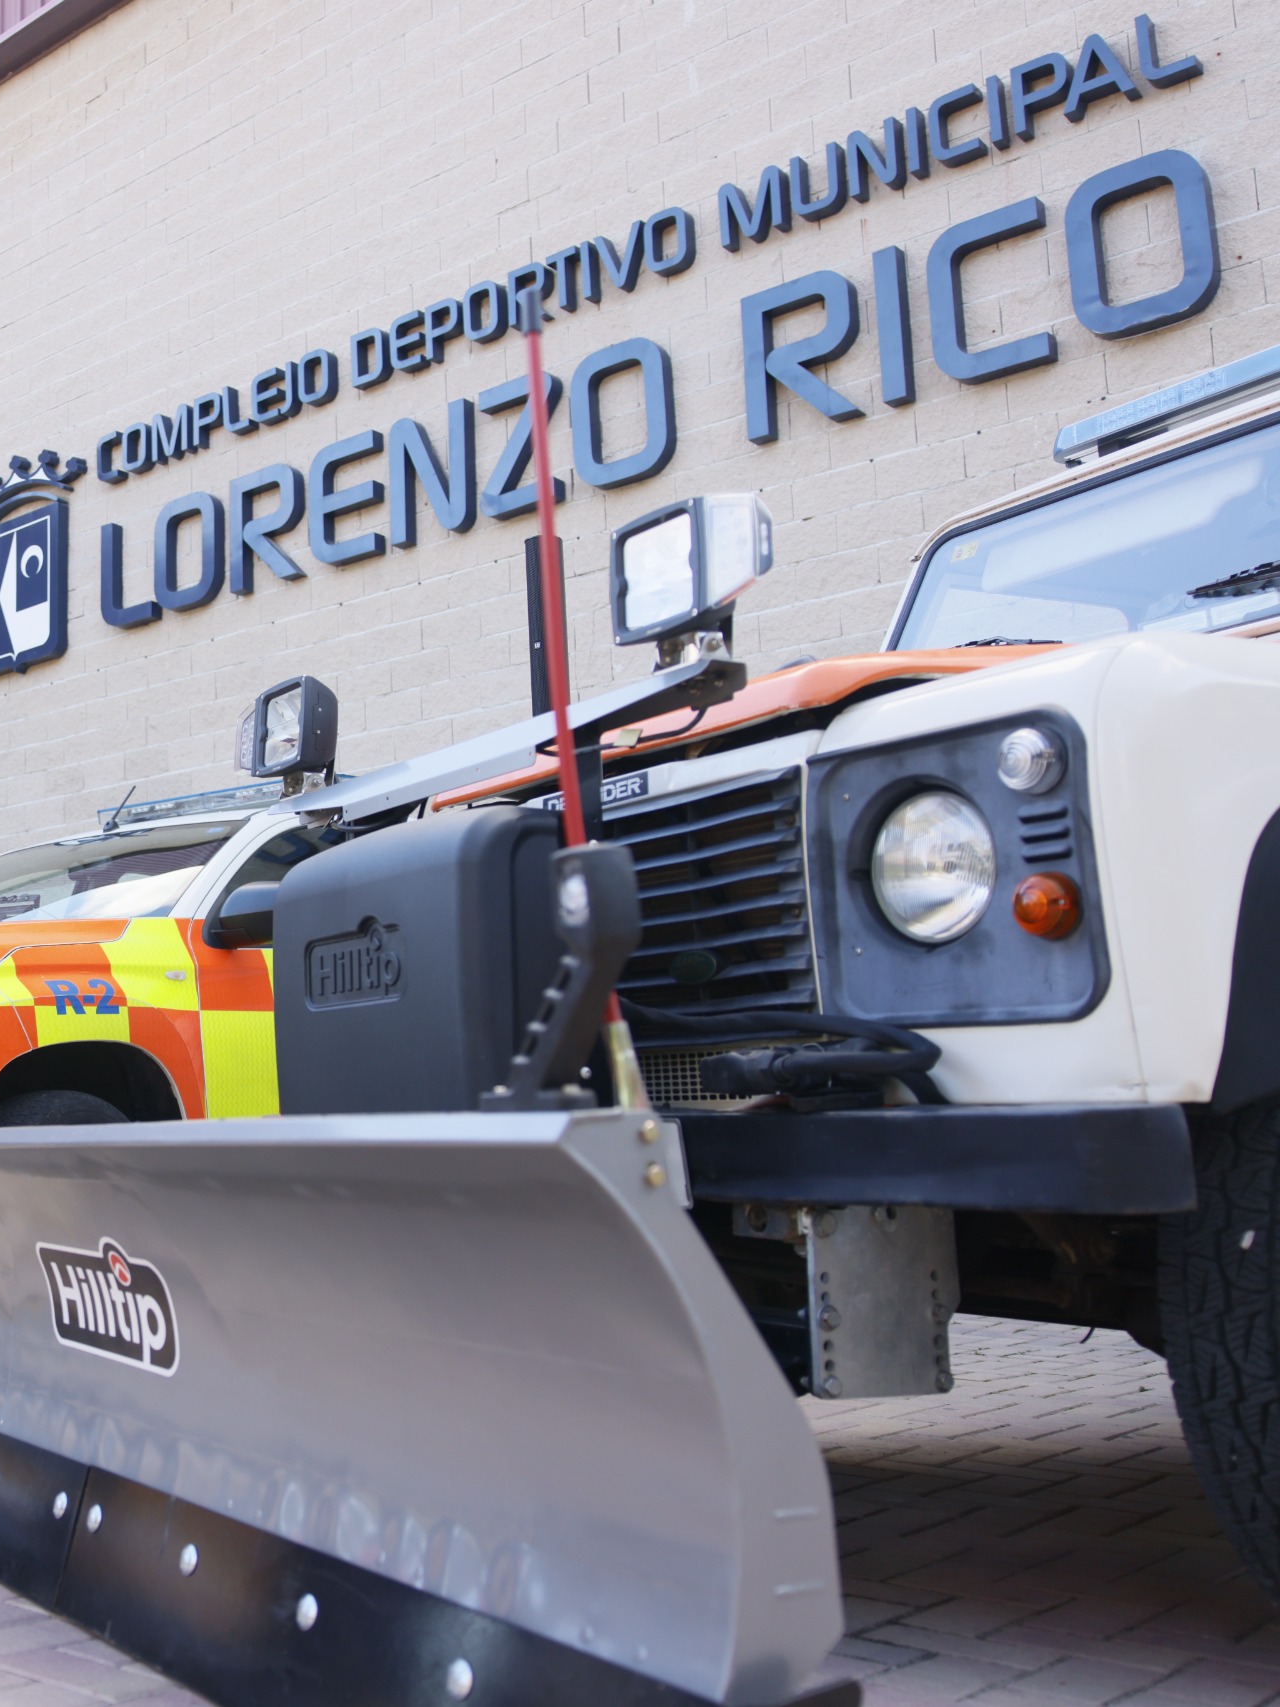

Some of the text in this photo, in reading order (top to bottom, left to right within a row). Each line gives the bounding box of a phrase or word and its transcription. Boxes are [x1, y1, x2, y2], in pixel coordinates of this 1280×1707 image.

[96, 14, 1205, 484] COMPLEJO DEPORTIVO MUNICIPAL
[100, 149, 1221, 629] LORENZO RICO
[43, 978, 120, 1015] R-2
[317, 946, 402, 997] Hilltip
[50, 1261, 167, 1365] Hilltip
